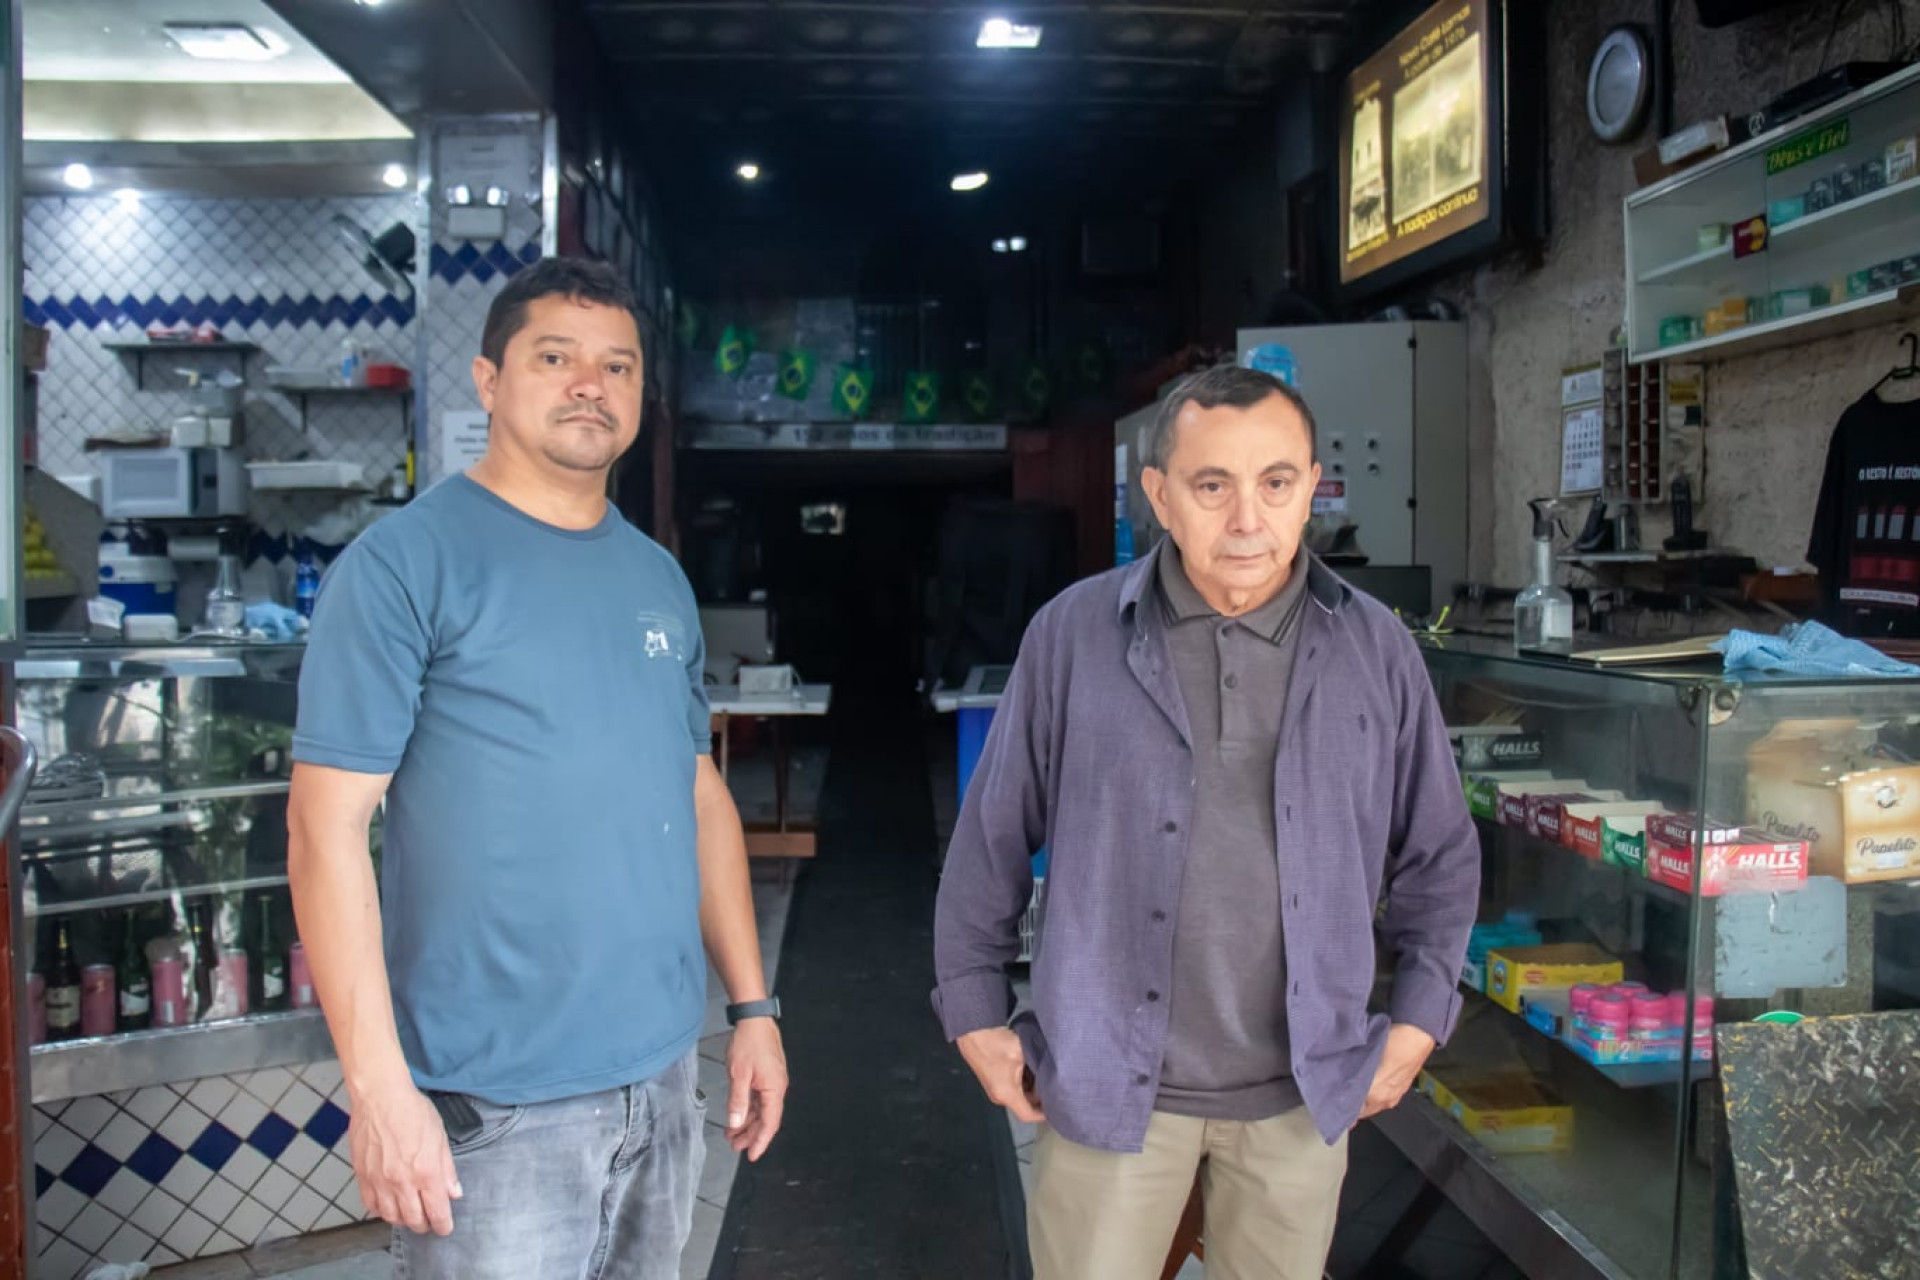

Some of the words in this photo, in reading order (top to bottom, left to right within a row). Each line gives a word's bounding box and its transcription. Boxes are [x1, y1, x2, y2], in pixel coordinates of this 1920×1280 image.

[1438, 187, 1479, 217] continua
[1492, 741, 1541, 756] HALLS
[1472, 792, 1490, 806] HALLS
[1505, 802, 1524, 818] HALLS
[1537, 813, 1559, 831] HALLS
[1574, 826, 1598, 843] HALLS
[1665, 823, 1688, 840] HALLS
[1614, 840, 1642, 860] HALLS
[1660, 855, 1691, 874] HALLS
[1738, 852, 1802, 869] HALLS
